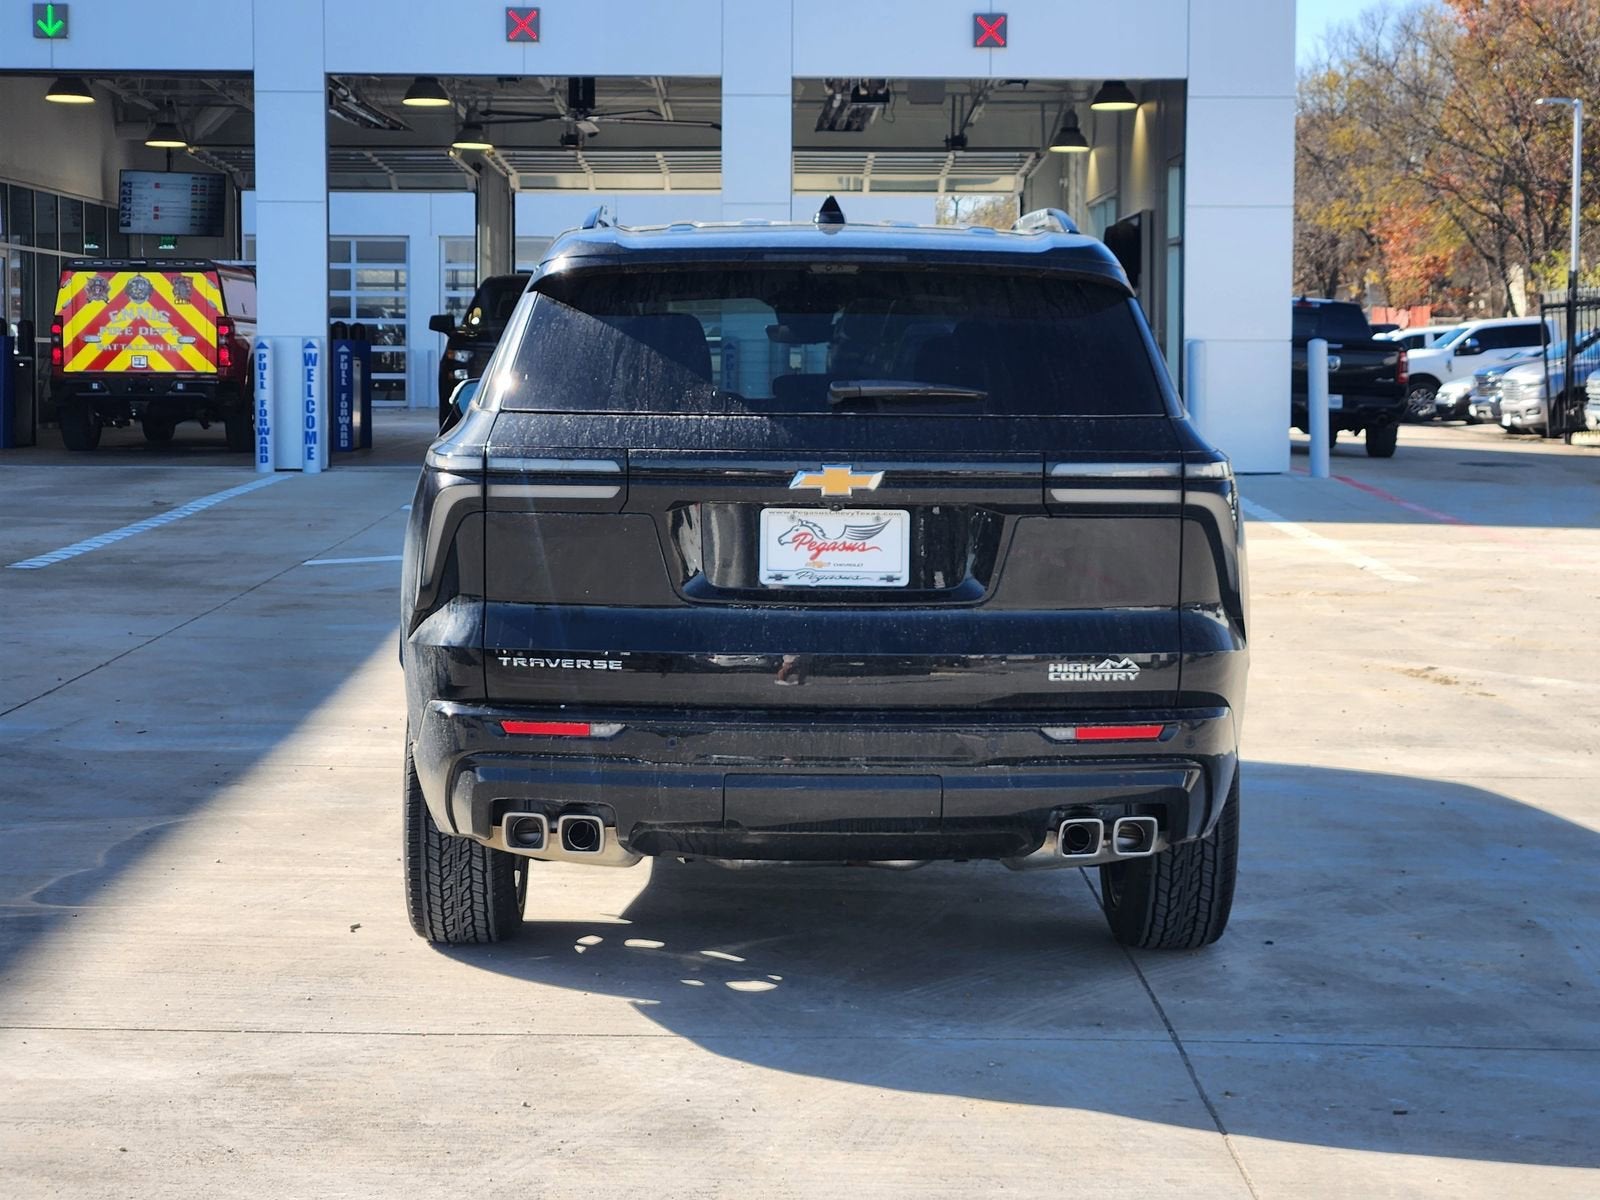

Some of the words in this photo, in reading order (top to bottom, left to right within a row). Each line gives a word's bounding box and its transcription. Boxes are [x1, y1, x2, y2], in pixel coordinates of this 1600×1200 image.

[99, 326, 133, 336] FIRE
[258, 353, 267, 389] PULL
[340, 354, 348, 386] PULL
[303, 352, 318, 461] WELCOME
[338, 393, 350, 448] FORWARD
[257, 400, 270, 463] FORWARD
[792, 532, 882, 560] Pegasus
[498, 656, 623, 670] TRAVERSE
[1048, 663, 1098, 672] HIGH
[1048, 672, 1140, 681] COUNTRY
